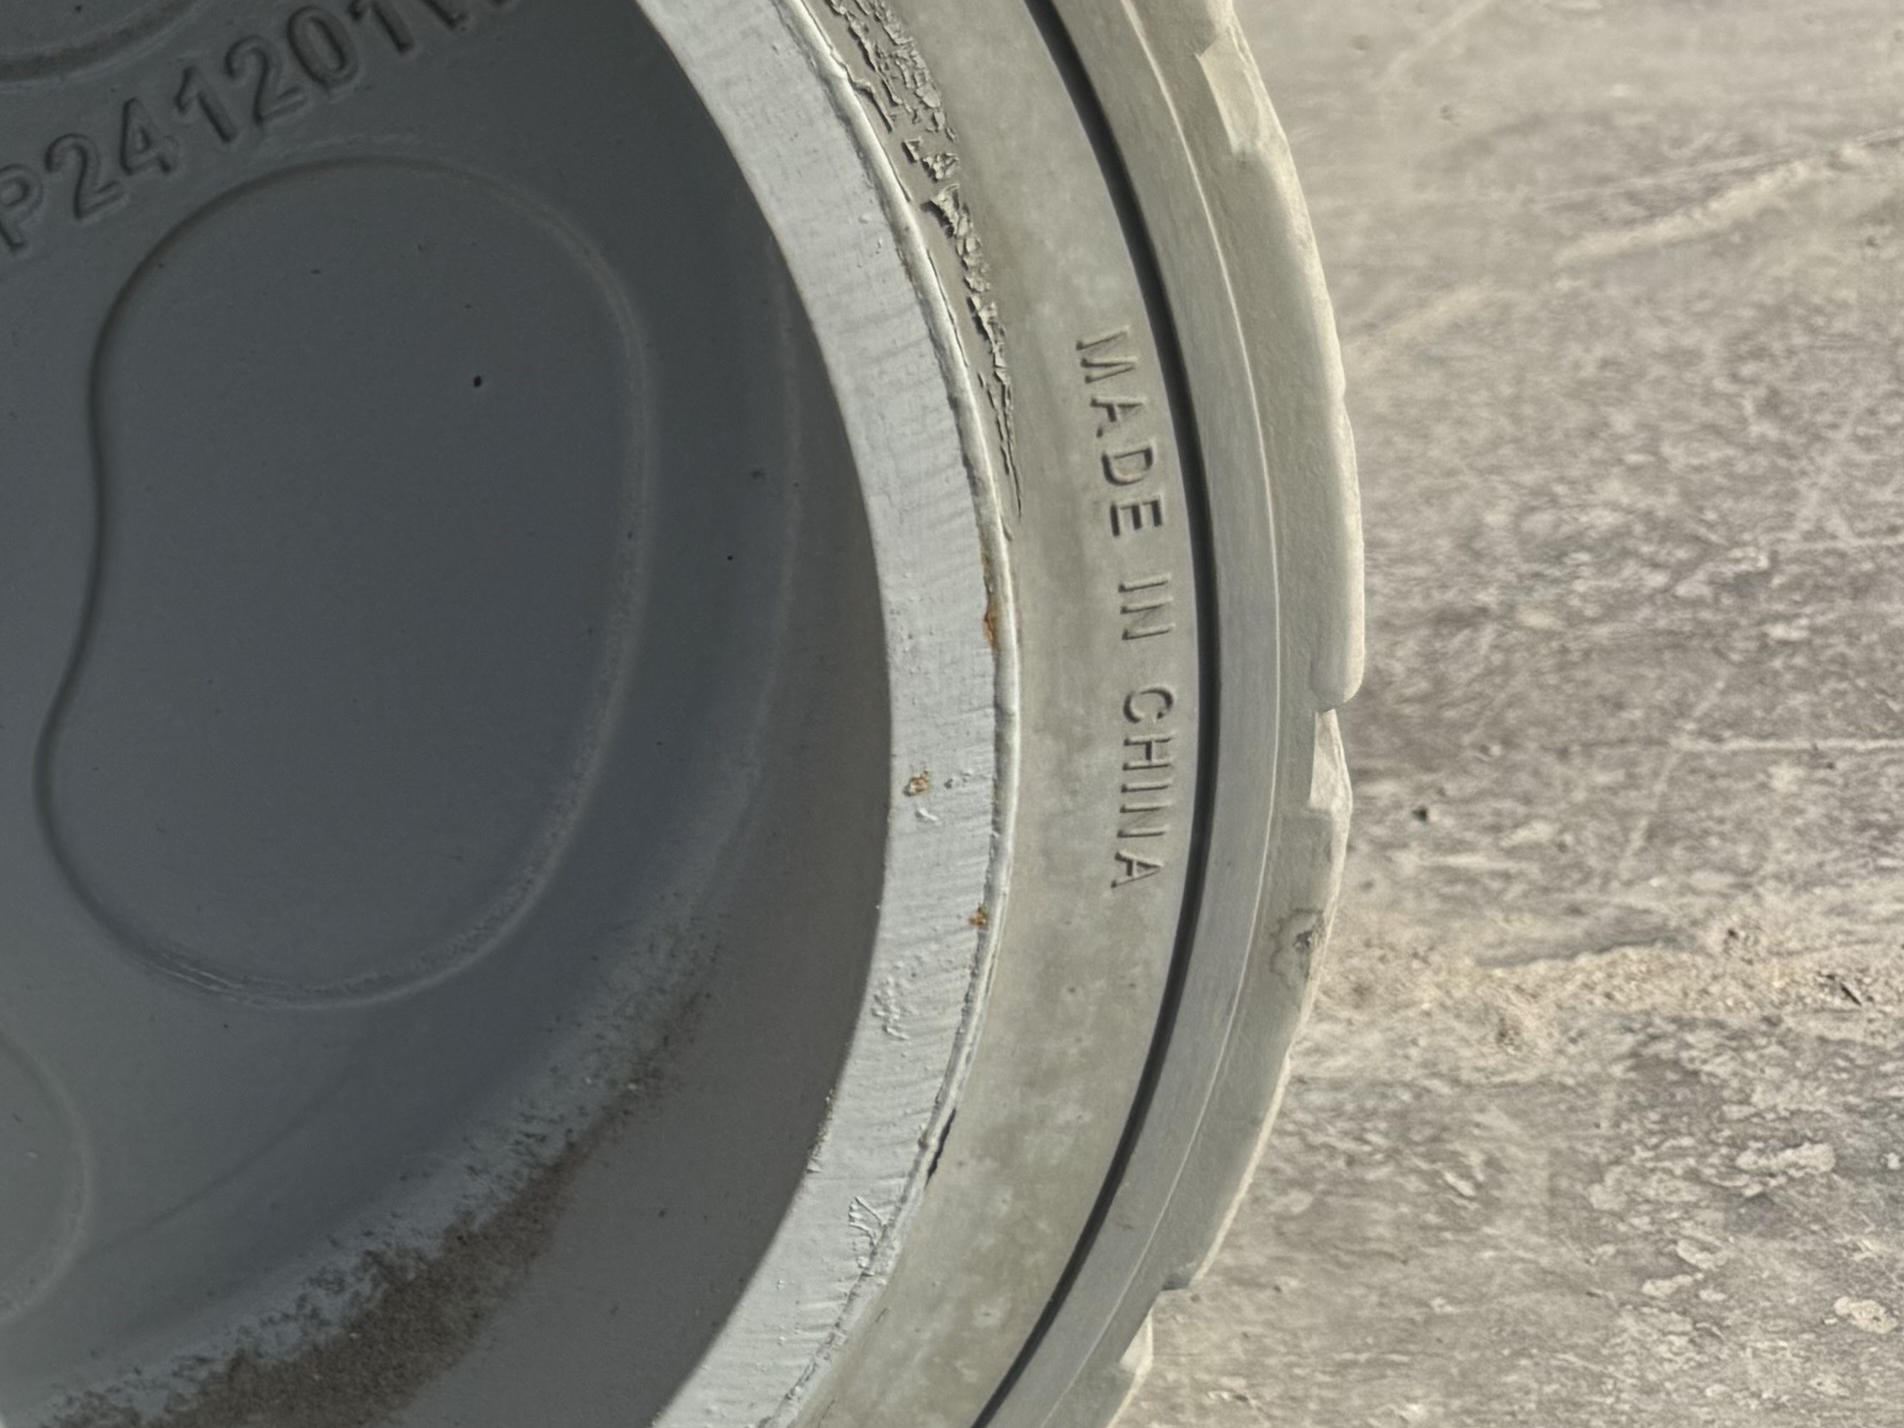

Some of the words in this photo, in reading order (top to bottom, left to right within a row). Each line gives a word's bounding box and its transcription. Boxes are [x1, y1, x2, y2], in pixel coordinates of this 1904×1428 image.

[1075, 325, 1166, 538] MADE
[1118, 577, 1175, 643] IN
[1111, 683, 1175, 890] CHINA
